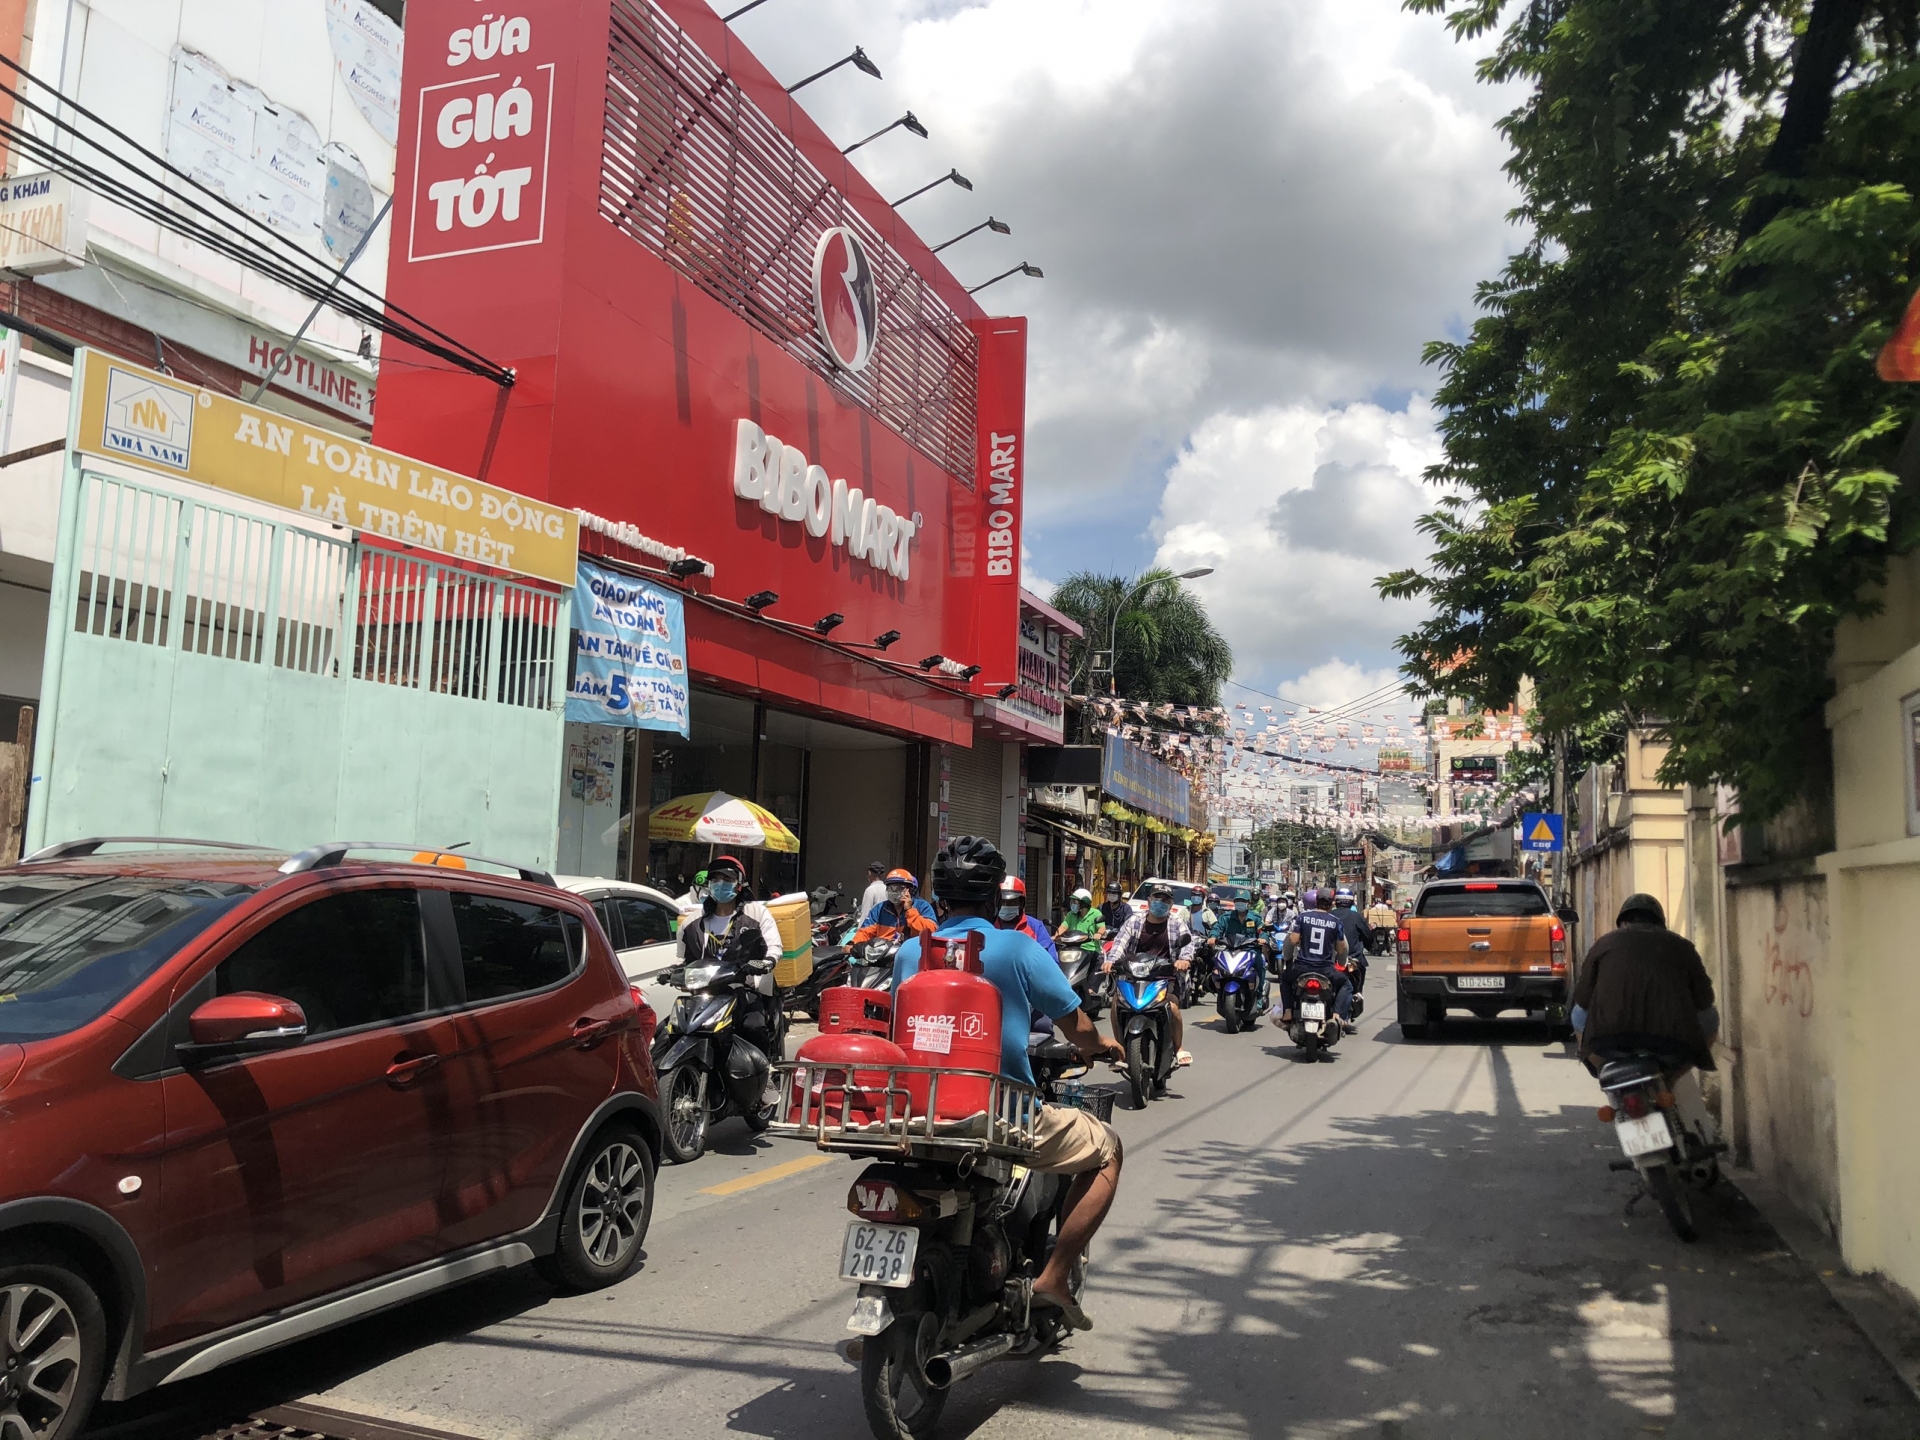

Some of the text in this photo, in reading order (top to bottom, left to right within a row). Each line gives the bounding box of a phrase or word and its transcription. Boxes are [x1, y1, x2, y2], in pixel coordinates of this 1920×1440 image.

[447, 13, 531, 67] SỮA
[436, 76, 533, 149] GIÁ
[13, 177, 51, 200] KHÁM
[428, 152, 532, 232] TỐT
[16, 203, 63, 255] KHOA
[110, 433, 183, 464] NHÀ NAM
[234, 413, 565, 540] AN TOÀN LAO ĐỘNG
[734, 418, 916, 581] BIBO MART
[987, 432, 1016, 577] BIBO MART
[300, 484, 515, 568] LÀ TRÊN HẾT
[590, 579, 626, 604] GIAO
[614, 609, 655, 631] TOÀN
[577, 635, 600, 652] AN
[605, 638, 632, 660] TÂM
[575, 676, 607, 696] IẢM
[1309, 927, 1325, 955] 9
[850, 1253, 902, 1281] 2038
